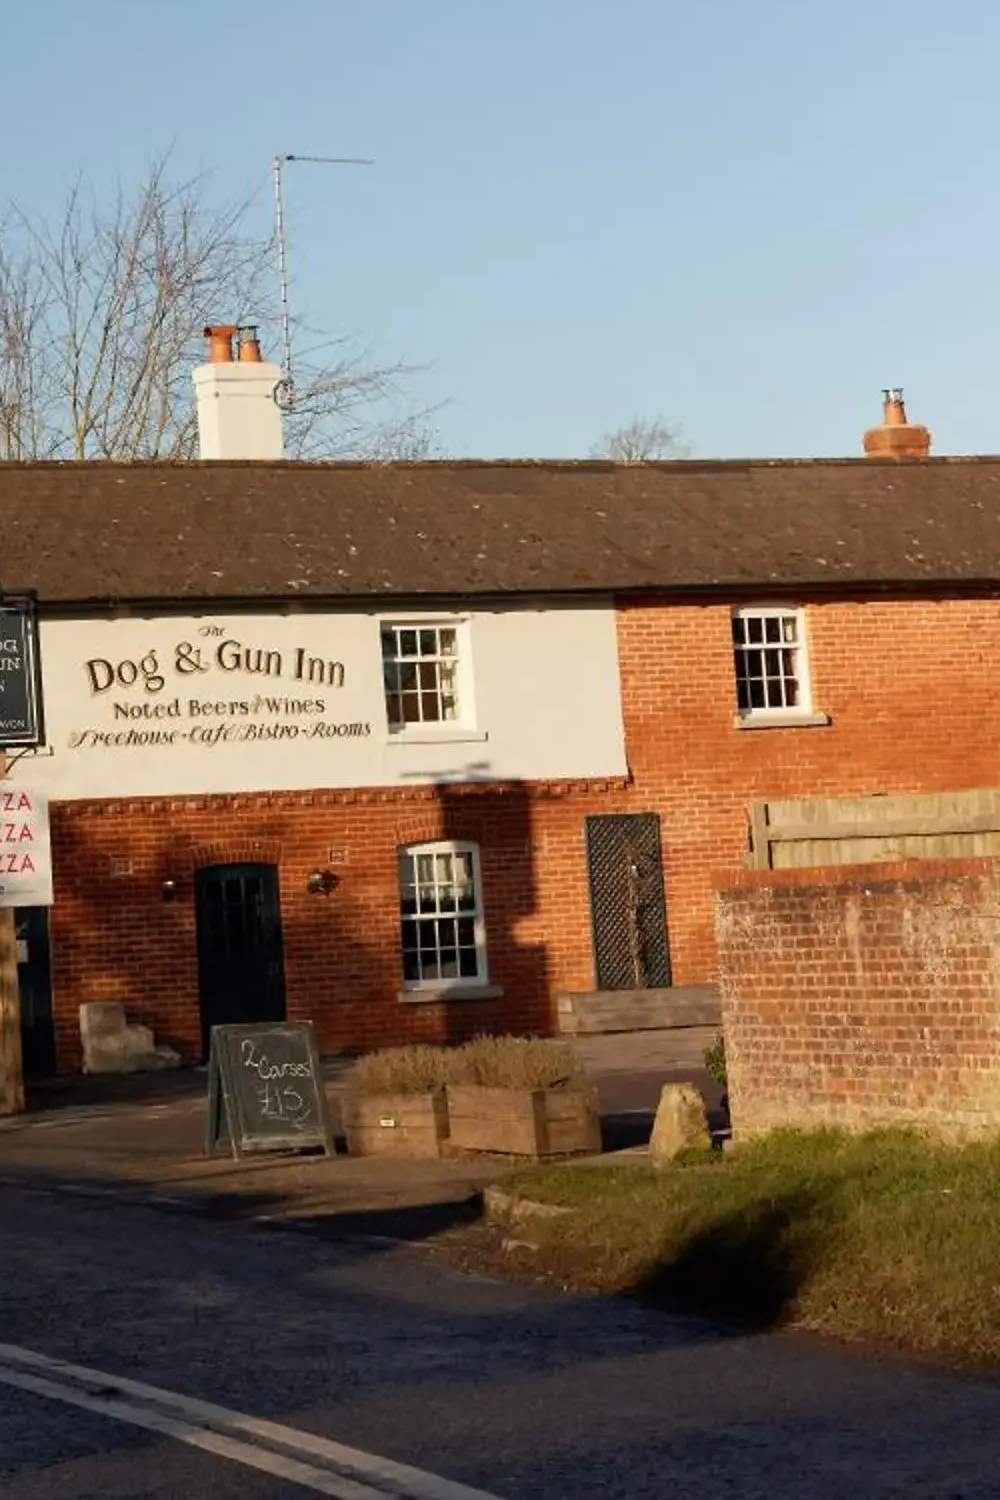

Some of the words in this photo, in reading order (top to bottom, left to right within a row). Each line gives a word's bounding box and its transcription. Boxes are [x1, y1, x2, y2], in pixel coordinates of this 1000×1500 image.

[86, 650, 165, 693] Dog
[175, 641, 209, 674] &
[217, 640, 282, 676] Gun
[294, 647, 345, 687] Inn
[114, 699, 181, 720] Noted
[190, 699, 249, 716] Beers
[265, 697, 325, 715] Wines
[311, 721, 371, 740] Rooms
[241, 1040, 259, 1066] 2
